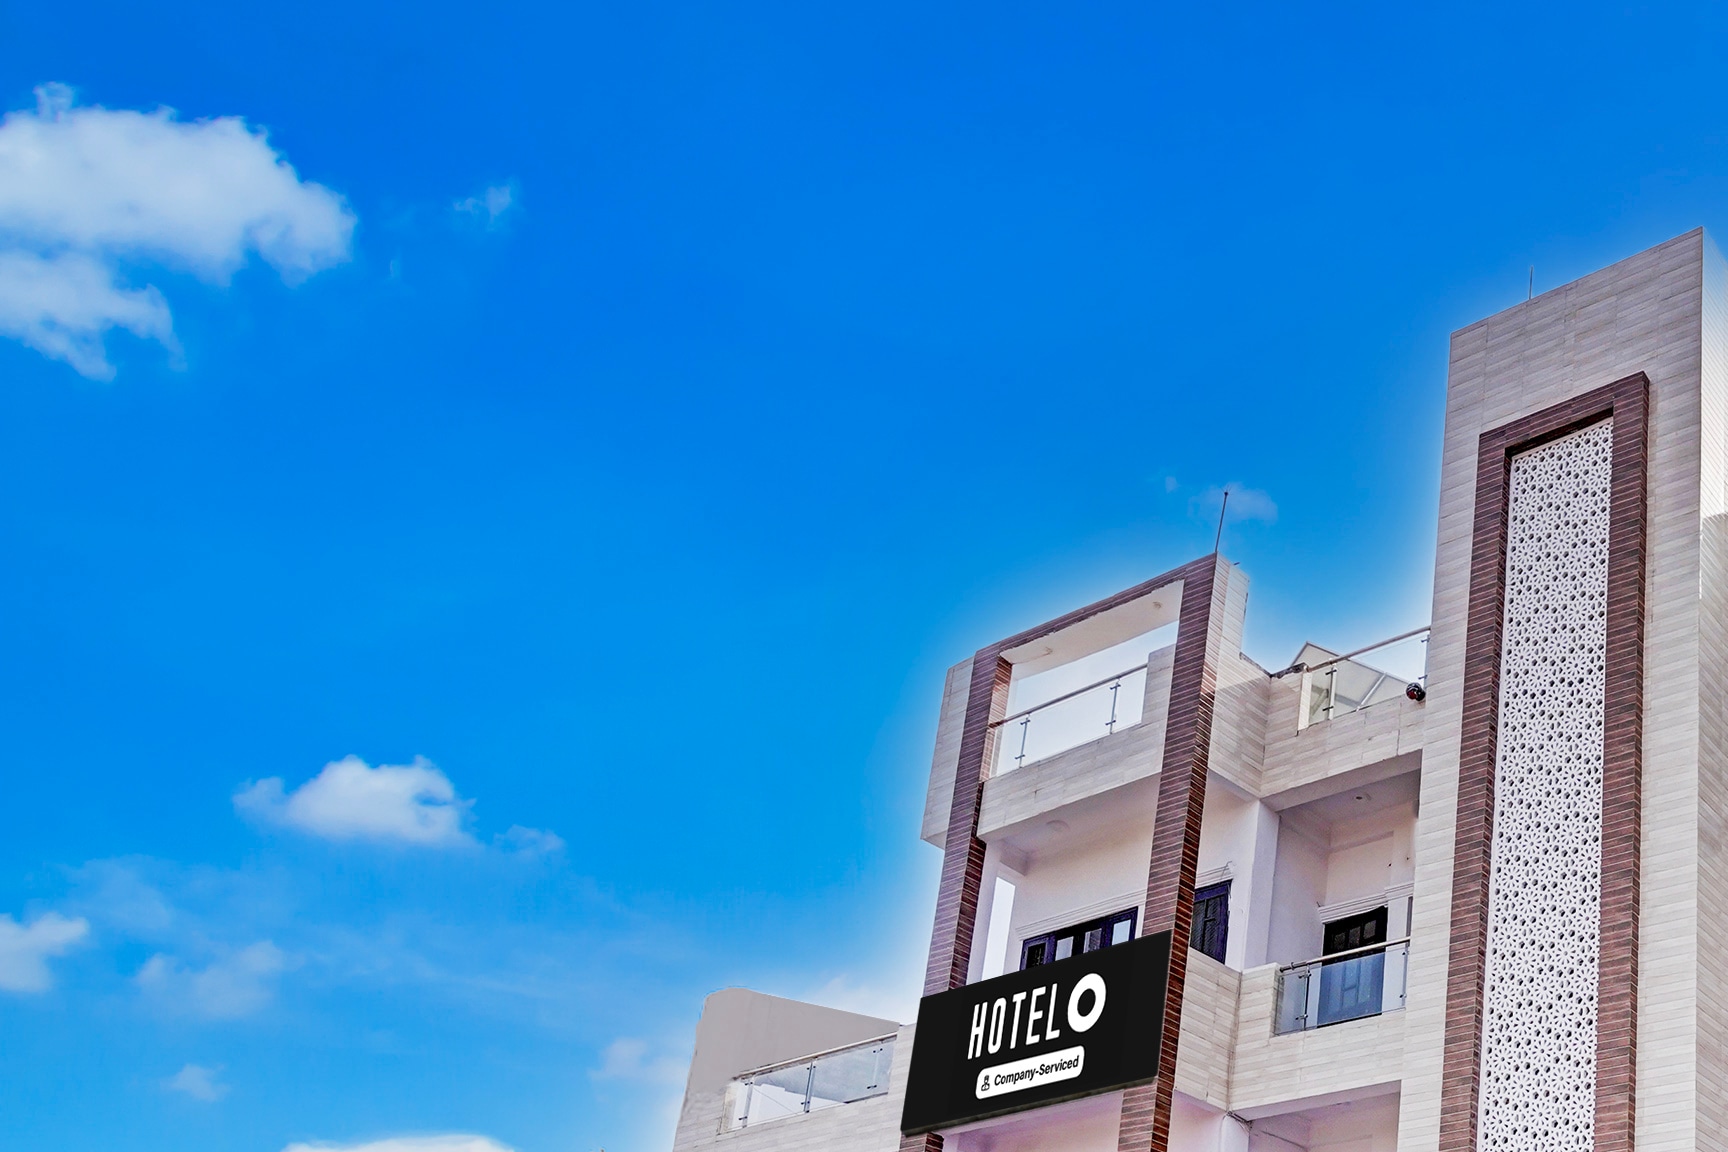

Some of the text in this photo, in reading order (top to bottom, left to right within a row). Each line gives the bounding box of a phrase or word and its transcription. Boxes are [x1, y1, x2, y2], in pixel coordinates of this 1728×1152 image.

[967, 972, 1107, 1060] HOTEL O
[994, 1055, 1080, 1086] Company-Serviced
